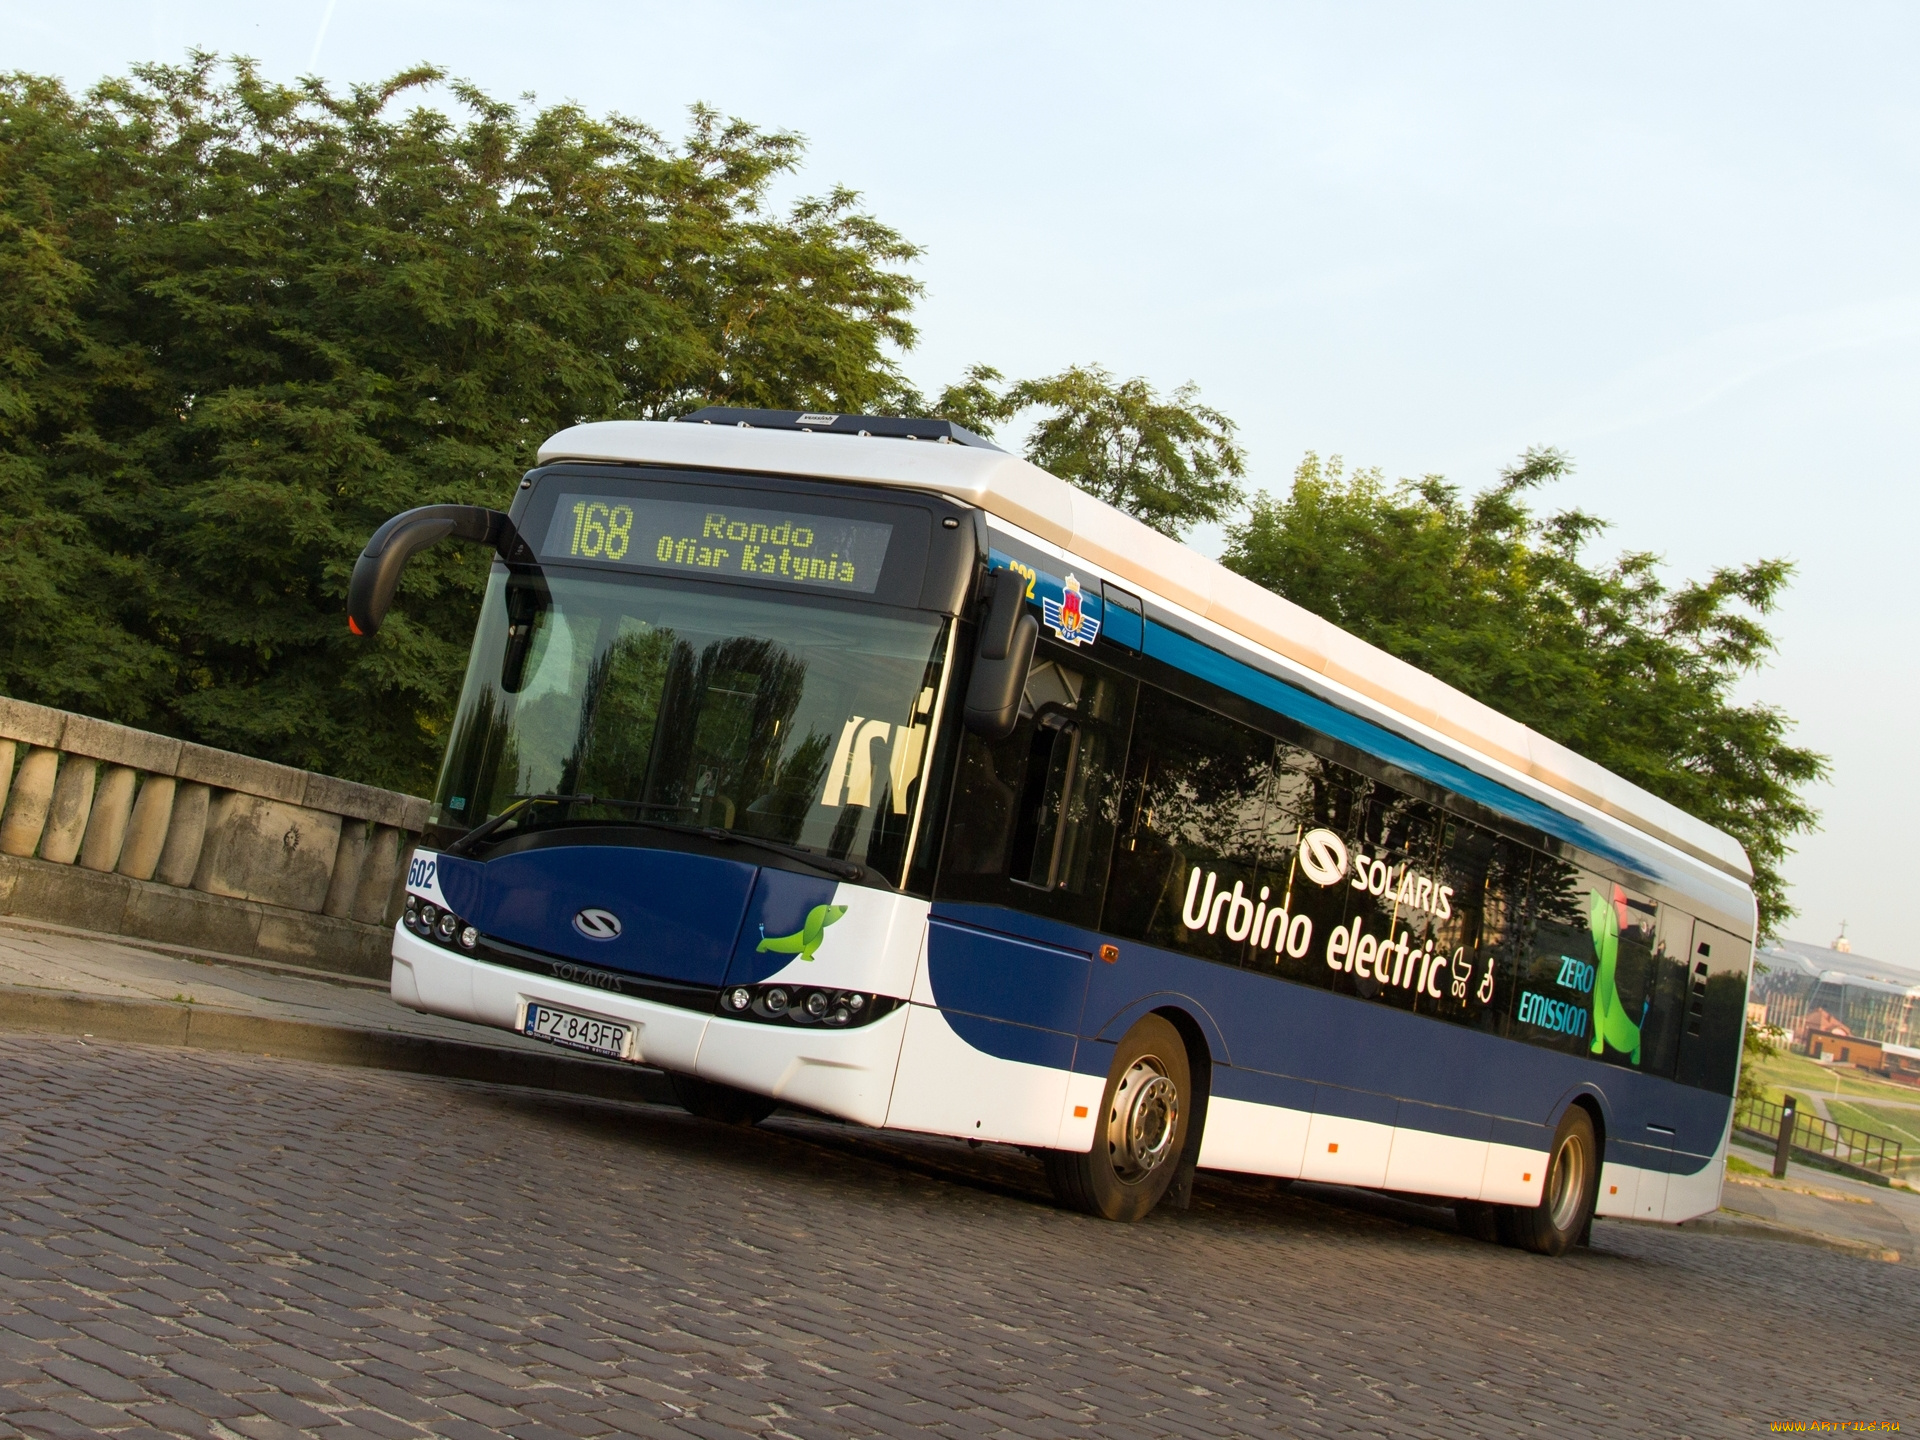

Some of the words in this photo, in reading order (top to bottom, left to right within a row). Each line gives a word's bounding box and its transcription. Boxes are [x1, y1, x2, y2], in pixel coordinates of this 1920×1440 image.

[571, 501, 634, 560] 168
[703, 513, 815, 548] Rondo
[656, 535, 729, 567] Ofiar
[741, 544, 855, 582] Katynia
[408, 858, 436, 889] 602
[1351, 854, 1454, 920] SOLARIS
[1182, 866, 1313, 959] Urbino
[1326, 916, 1447, 999] electric
[550, 962, 625, 991] SOLARIS
[1556, 955, 1595, 993] ZERO
[537, 1010, 564, 1035] PZ
[568, 1018, 624, 1050] 843FR
[1518, 991, 1587, 1038] EMISSION
